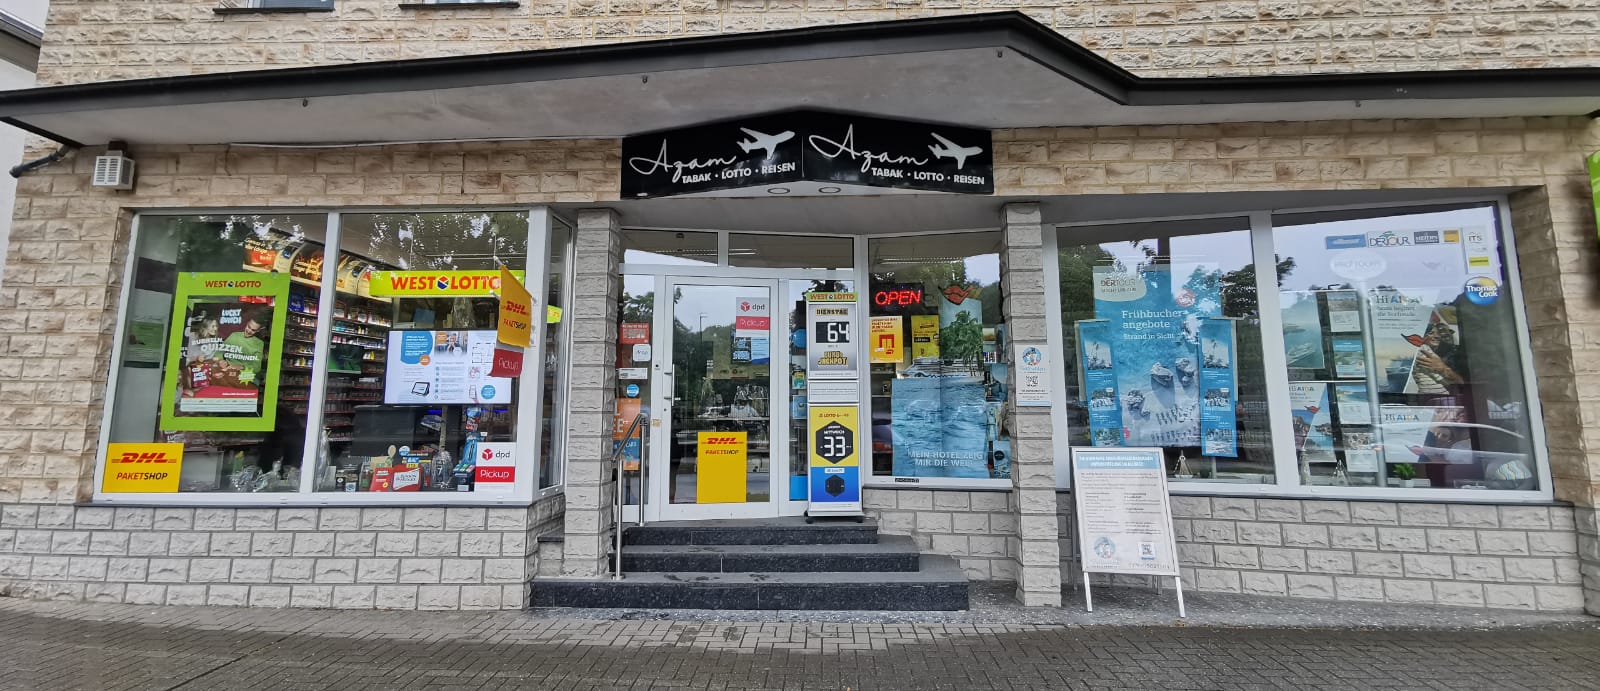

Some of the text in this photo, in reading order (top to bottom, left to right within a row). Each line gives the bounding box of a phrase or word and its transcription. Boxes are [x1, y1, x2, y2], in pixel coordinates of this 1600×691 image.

[809, 124, 929, 172] Azam
[629, 138, 737, 183] Azam
[682, 162, 796, 184] TABAK LOTTO REISEN
[871, 166, 985, 185] TABAK LOTTO REISEN
[204, 280, 262, 288] WEST LOTTO
[391, 275, 501, 290] WEST LOTTO
[1466, 285, 1498, 293] Thomas
[875, 290, 922, 305] OPEN
[505, 300, 528, 316] DHL
[752, 303, 765, 312] dpd
[1122, 320, 1171, 331] angebote
[827, 322, 849, 342] 64
[201, 344, 243, 354] QUIZZEN.
[823, 436, 846, 457] 33
[119, 452, 169, 464] DHL
[495, 450, 511, 459] dpd
[933, 451, 961, 459] HOTEL
[934, 459, 949, 467] DIE
[116, 472, 168, 481] PAKETSHOP
[480, 469, 510, 479] Pickup
